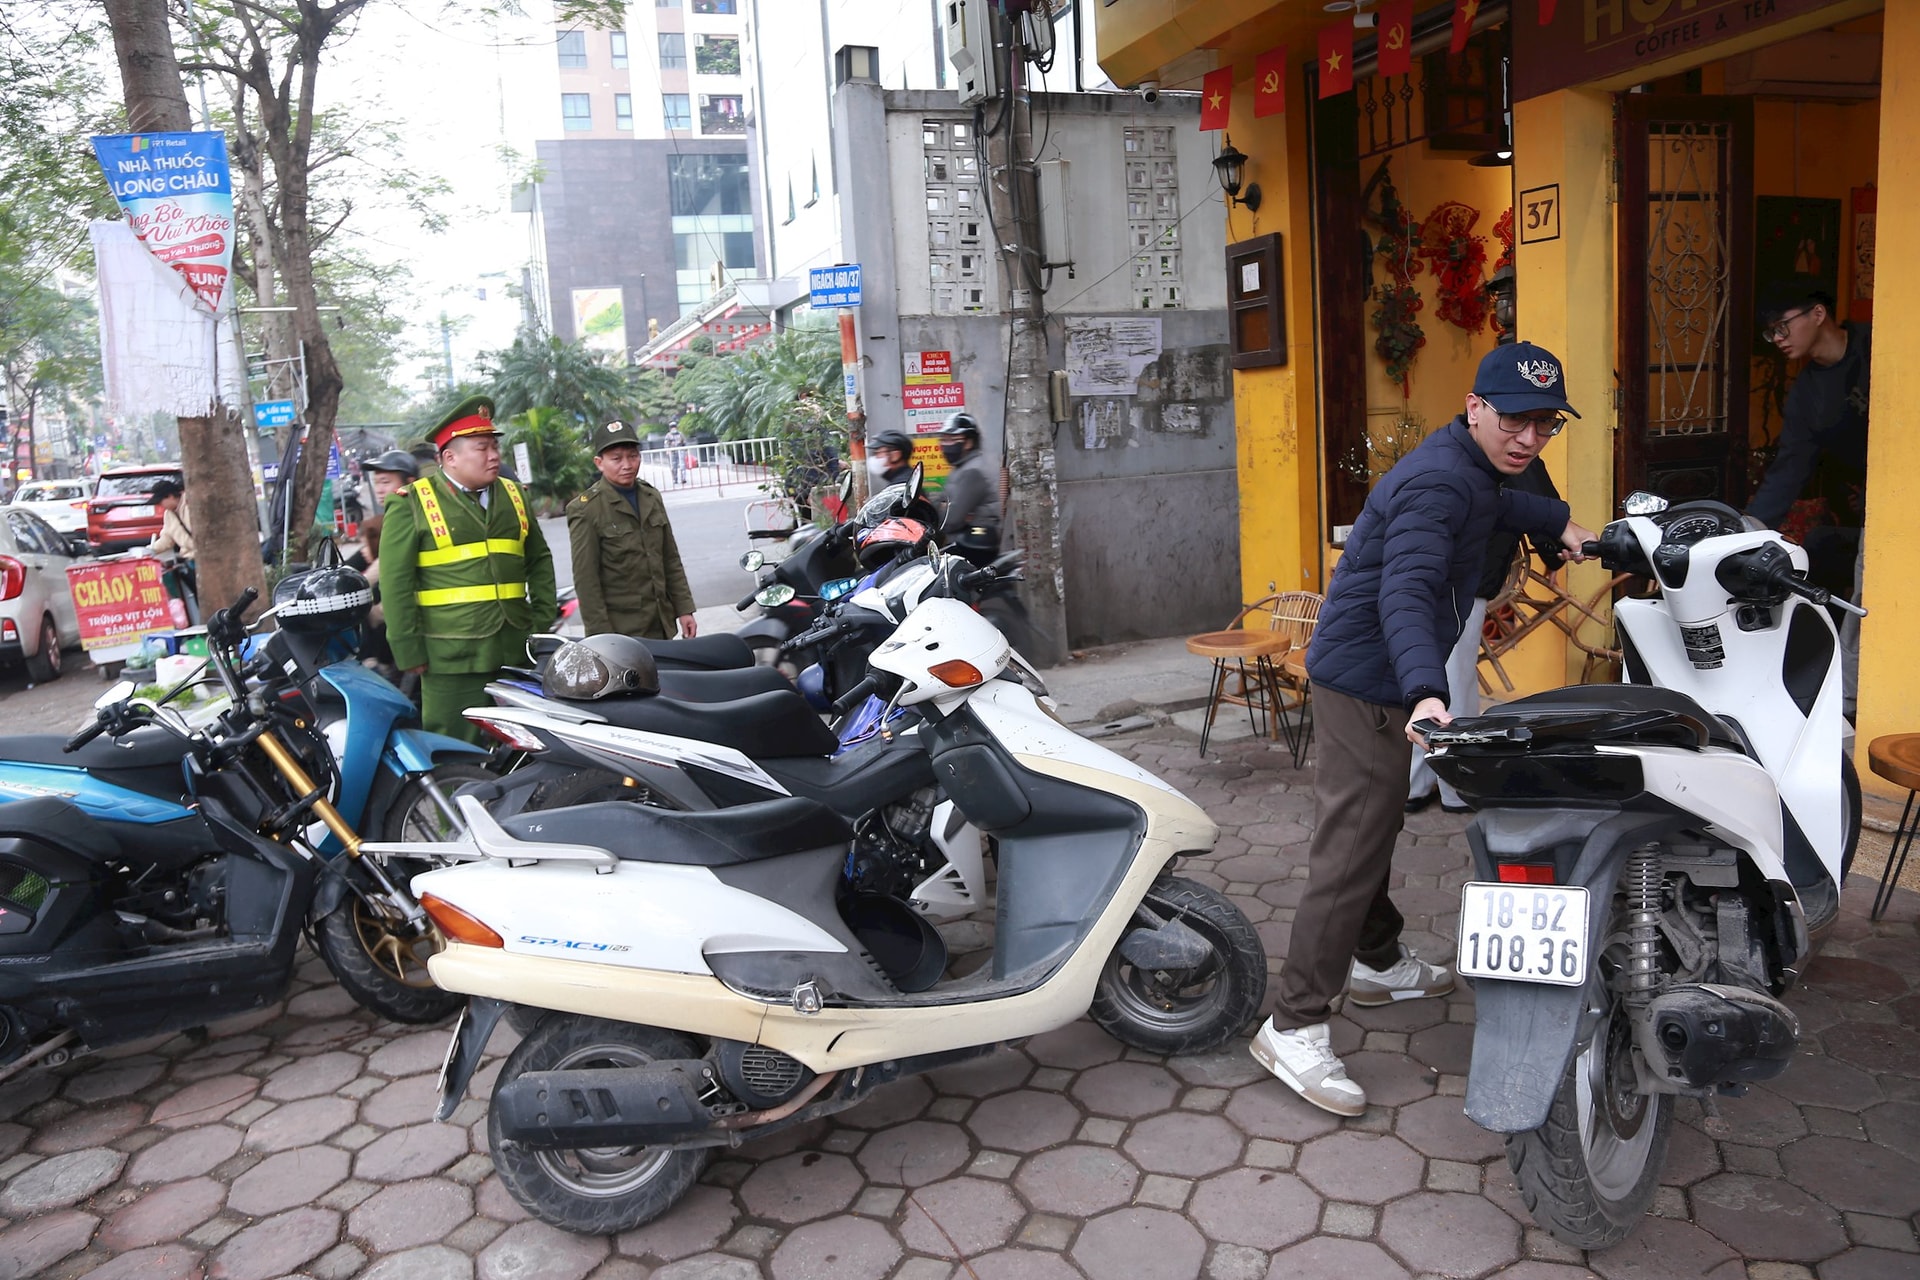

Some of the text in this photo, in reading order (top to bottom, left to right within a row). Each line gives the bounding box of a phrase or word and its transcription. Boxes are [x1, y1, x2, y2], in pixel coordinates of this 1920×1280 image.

[1634, 0, 1776, 57] COFFEE & TEA
[165, 139, 187, 147] Retail
[118, 151, 206, 174] NHÀ THUỐC
[114, 171, 219, 196] LONG CHÂU
[155, 200, 184, 224] Bà
[1527, 199, 1554, 229] 37
[145, 213, 231, 242] Vui Khỏe
[811, 270, 859, 290] NGÁCH 460/37
[1517, 360, 1559, 375] MARDI
[904, 385, 962, 397] KHÔNG ĐỔ RÁC
[924, 395, 957, 406] TẠI ĐÂY!
[271, 415, 289, 424] EXIT
[420, 486, 447, 537] CAHN
[75, 572, 125, 607] CHÁO
[140, 587, 162, 606] THỊT
[88, 607, 163, 627] TRỨNG VỊT LỘN
[104, 622, 134, 636] BÁNH
[609, 732, 682, 753] WINNER
[1483, 890, 1568, 932] 18-B2
[518, 935, 632, 952] SPACY 125
[1469, 932, 1578, 978] 108.36
